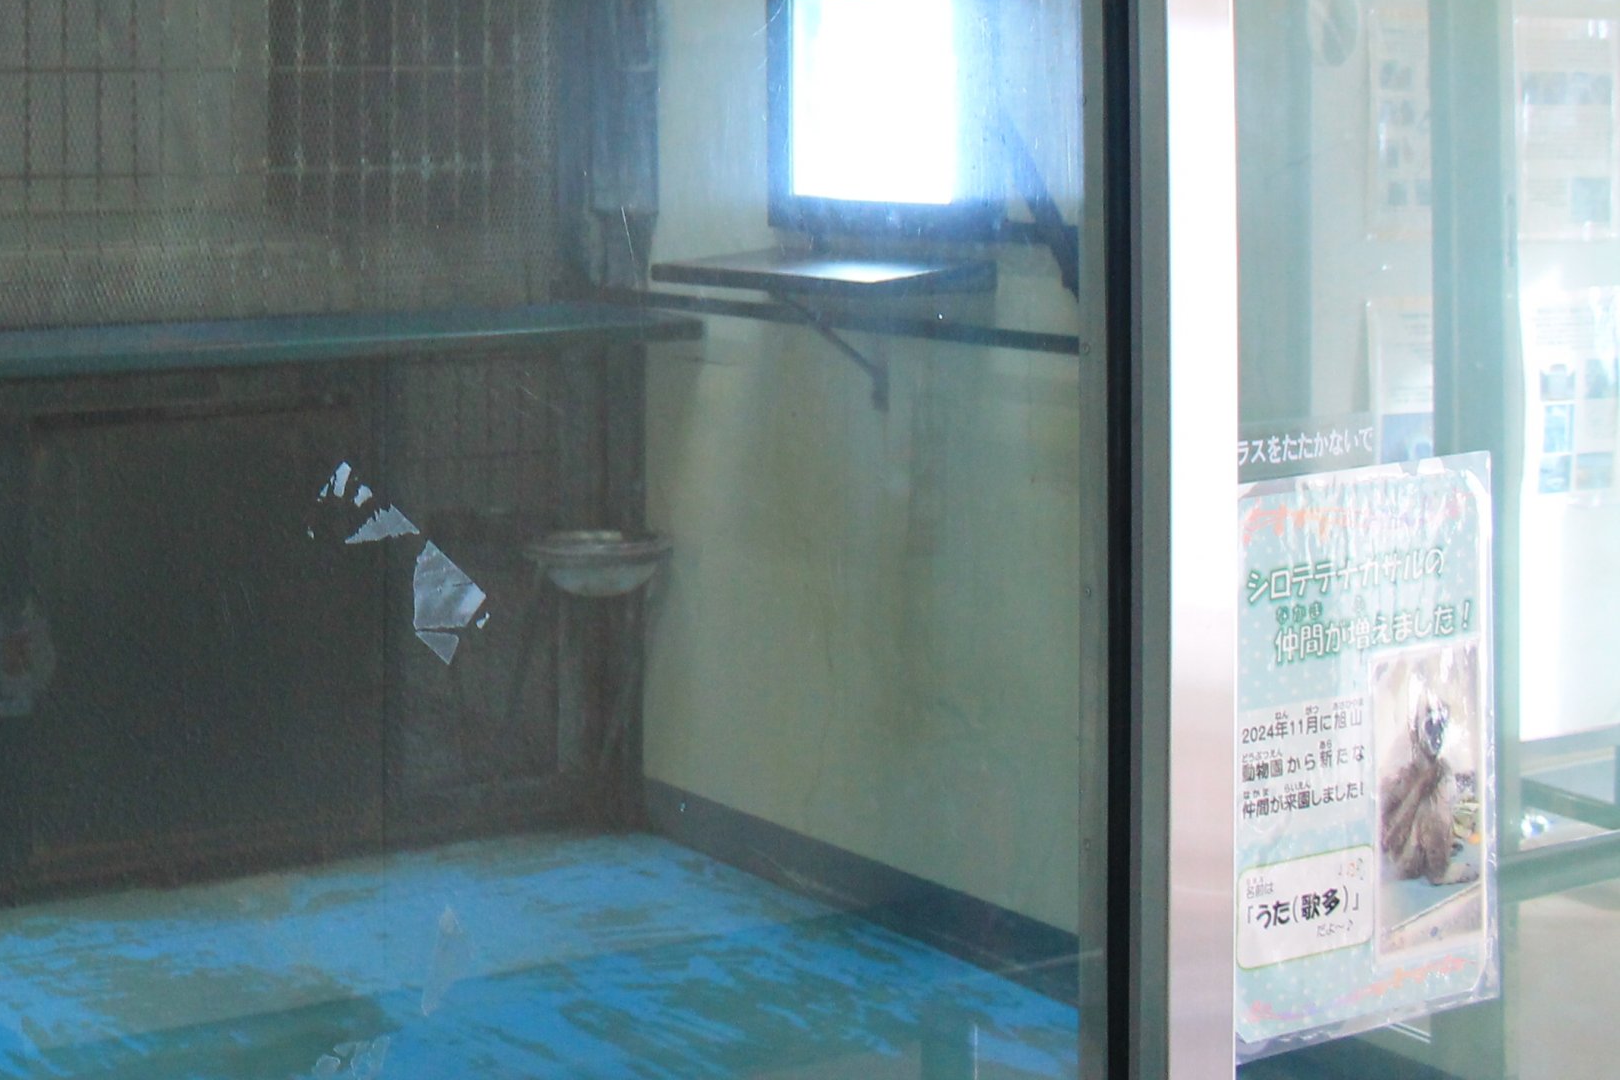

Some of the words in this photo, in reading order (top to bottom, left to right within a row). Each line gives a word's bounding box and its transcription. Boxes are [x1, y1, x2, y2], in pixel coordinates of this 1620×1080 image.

[1242, 709, 1362, 744] 2024年11月に旭山
[1242, 744, 1364, 782] 動物園から新たな
